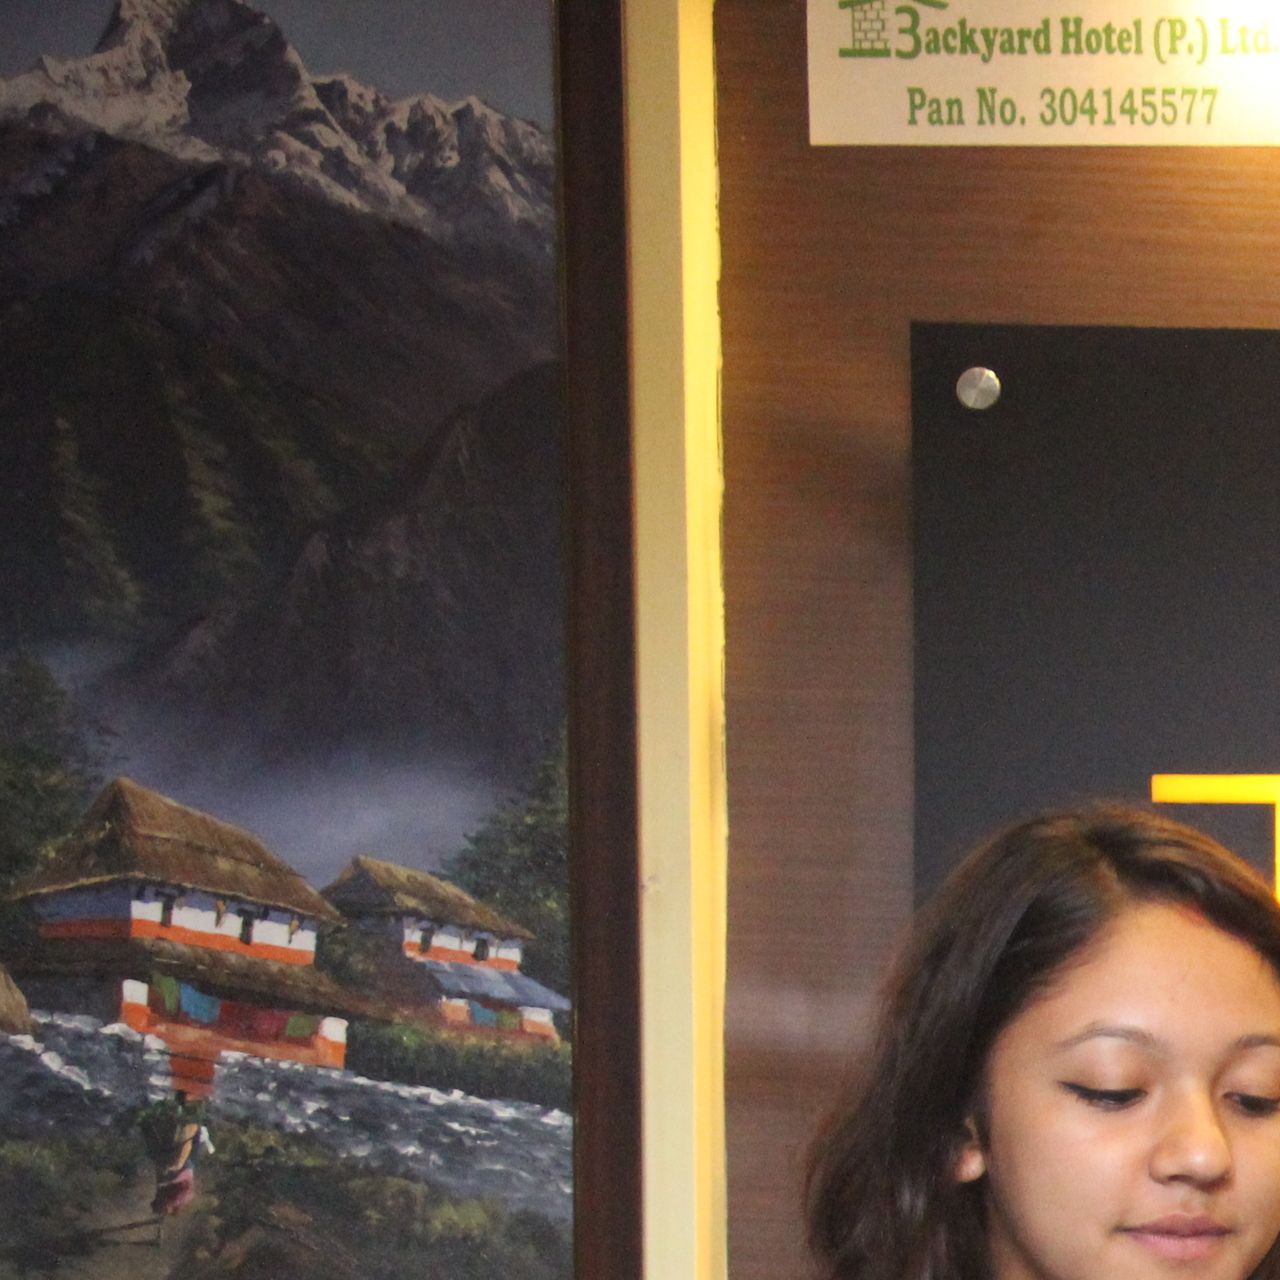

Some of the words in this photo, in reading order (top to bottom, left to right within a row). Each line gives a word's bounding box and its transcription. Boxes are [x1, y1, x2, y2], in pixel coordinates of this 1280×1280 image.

[895, 5, 1052, 63] Backyard
[1060, 16, 1143, 55] Hotel
[1153, 17, 1209, 65] (P.)
[906, 86, 965, 126] Pan
[976, 86, 1026, 126] No.
[1039, 86, 1219, 126] 304145577
